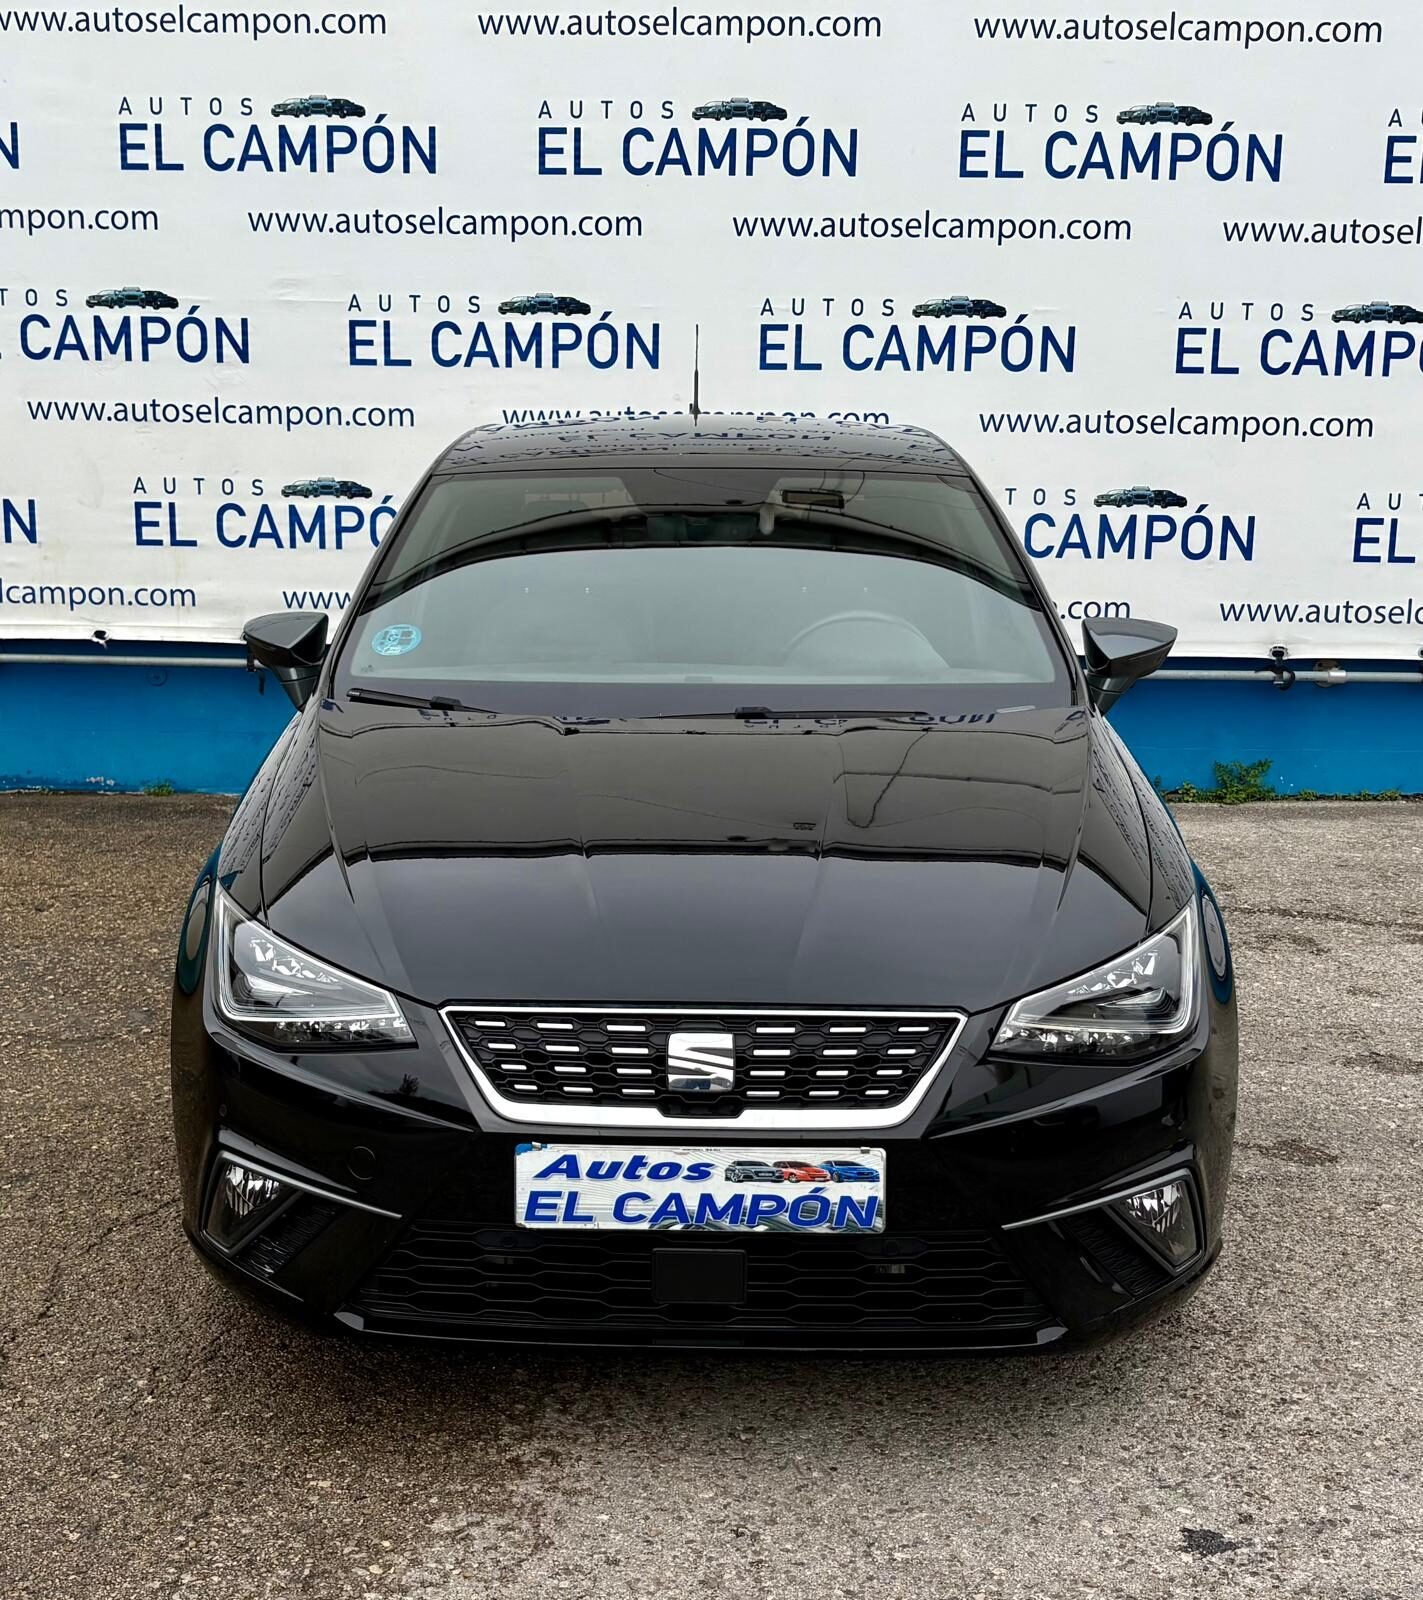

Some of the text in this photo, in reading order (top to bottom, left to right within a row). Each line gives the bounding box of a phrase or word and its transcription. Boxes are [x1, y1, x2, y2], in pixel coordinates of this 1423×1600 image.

[478, 7, 881, 43] www.autoselcampon.com
[974, 12, 1382, 49] www.autoselcampon.com
[118, 96, 253, 116] AUTOS
[538, 100, 674, 120] AUTOS
[960, 102, 1098, 124] AUTOS
[119, 114, 437, 174] EL CAMPÓN
[538, 117, 858, 176] EL CAMPÓN
[960, 121, 1283, 182] EL CAMPÓN
[1383, 135, 1423, 184] E
[248, 206, 642, 242] www.autoselcampon.com
[732, 209, 1131, 246] www.autoselcampon.com
[1223, 215, 1423, 245] www.autosel
[347, 293, 481, 314] AUTOS
[760, 297, 894, 317] AUTOS
[1178, 301, 1314, 322] AUTOS
[20, 305, 250, 364] CAMPÓN
[348, 310, 660, 370] EL CAMPÓN
[759, 314, 1076, 373] EL CAMPÓN
[1175, 327, 1423, 377] EL CAMP
[27, 396, 415, 432] www.autoselcampon.com
[979, 407, 1373, 443] www.autoselcampon.com
[133, 476, 264, 497] AUTOS
[1004, 487, 1076, 506] TOS
[3, 498, 38, 544] N
[134, 501, 198, 548] EL
[1024, 504, 1256, 561] CAMPÓN
[1352, 517, 1416, 564] EL
[1055, 600, 1131, 620] .com
[534, 1153, 715, 1181] Autos
[524, 1187, 879, 1228] EL CAMPÓN
